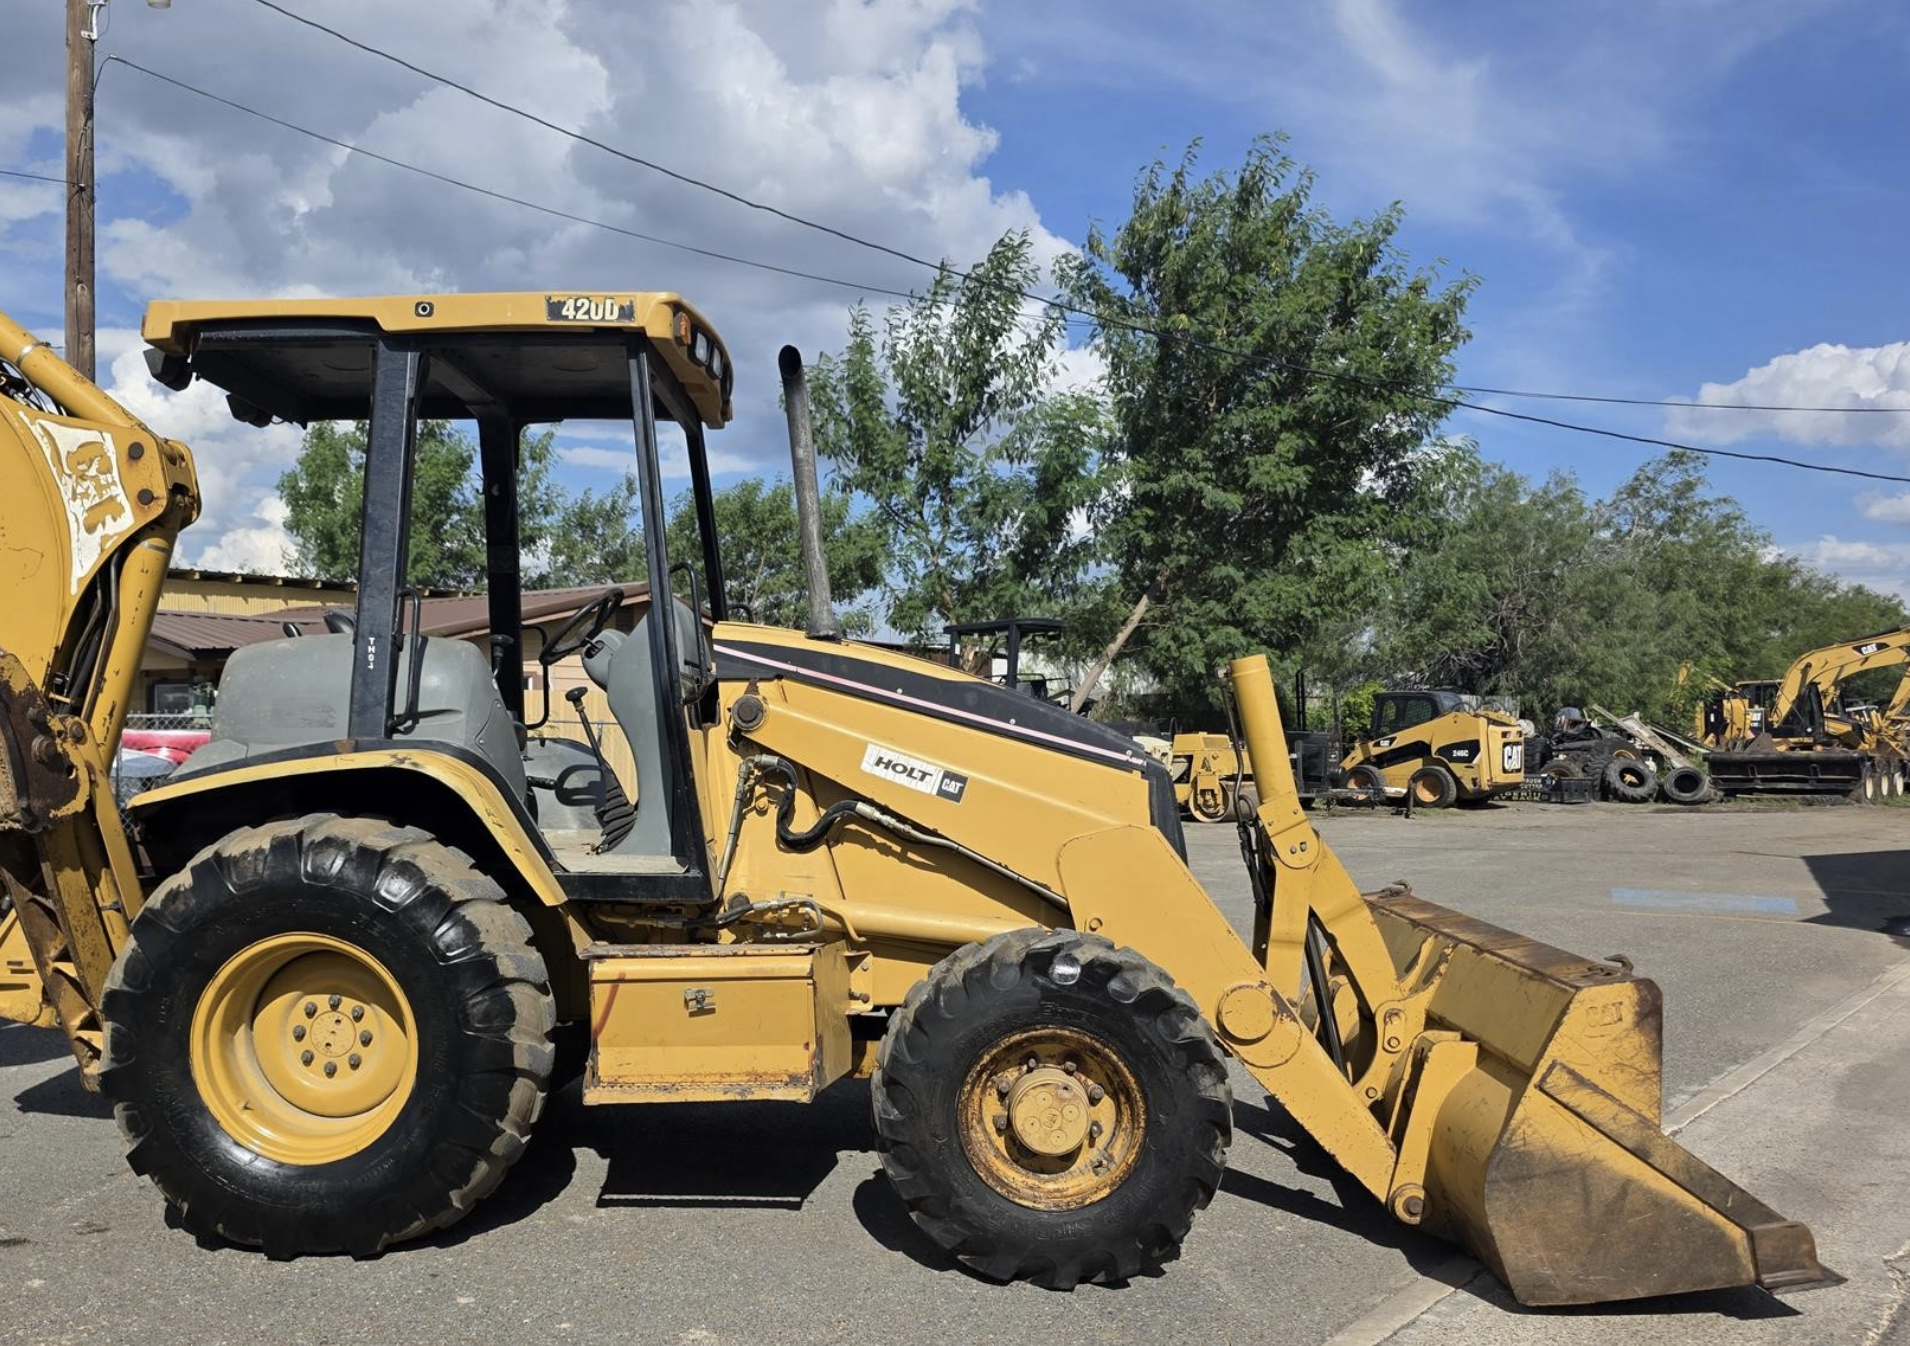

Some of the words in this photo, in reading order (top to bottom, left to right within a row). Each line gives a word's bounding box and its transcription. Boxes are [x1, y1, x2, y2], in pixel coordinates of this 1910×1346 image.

[561, 298, 620, 321] 420D
[1860, 643, 1878, 655] CAT
[1379, 739, 1391, 747] CAT
[1503, 744, 1522, 771] CAT
[874, 755, 934, 783] HOLT
[941, 777, 965, 795] CAT
